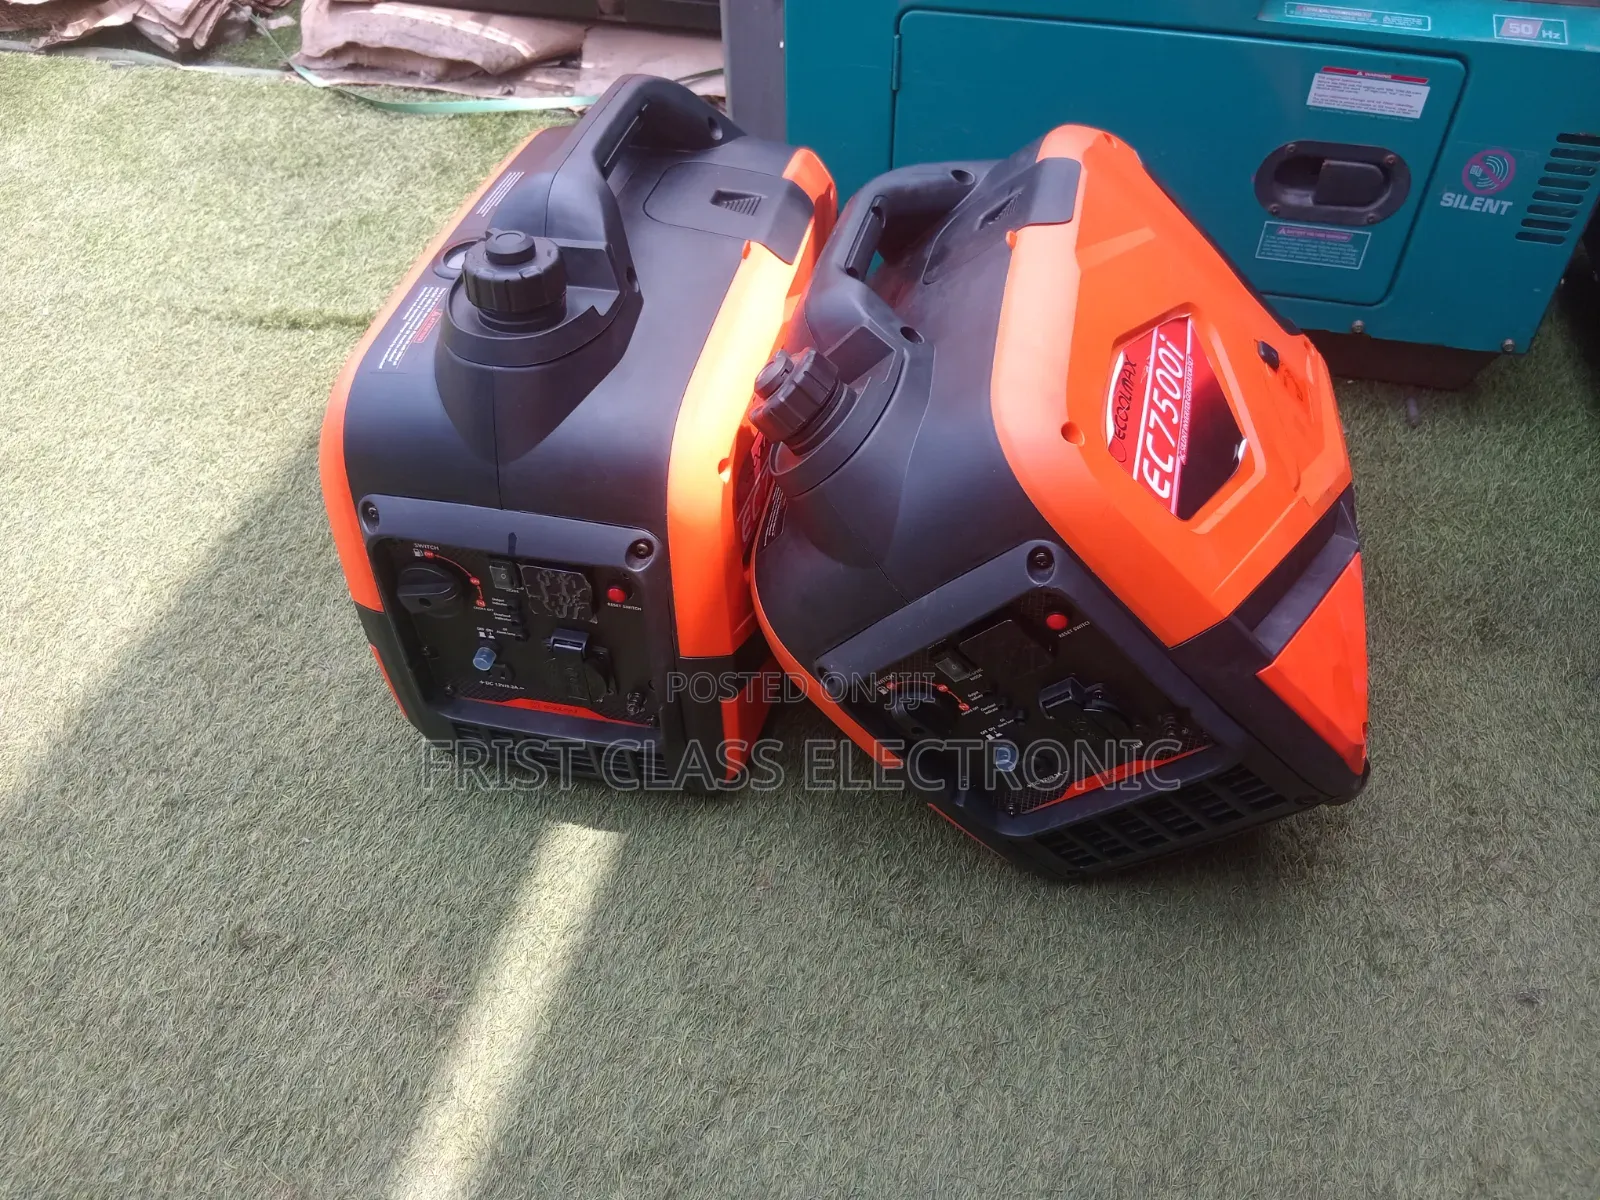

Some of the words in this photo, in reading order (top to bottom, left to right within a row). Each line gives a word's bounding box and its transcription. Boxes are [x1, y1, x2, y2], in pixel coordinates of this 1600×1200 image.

[1508, 23, 1533, 35] 50
[1541, 29, 1560, 39] Hz
[1440, 192, 1513, 216] SILENT
[1142, 333, 1184, 499] EC7500i
